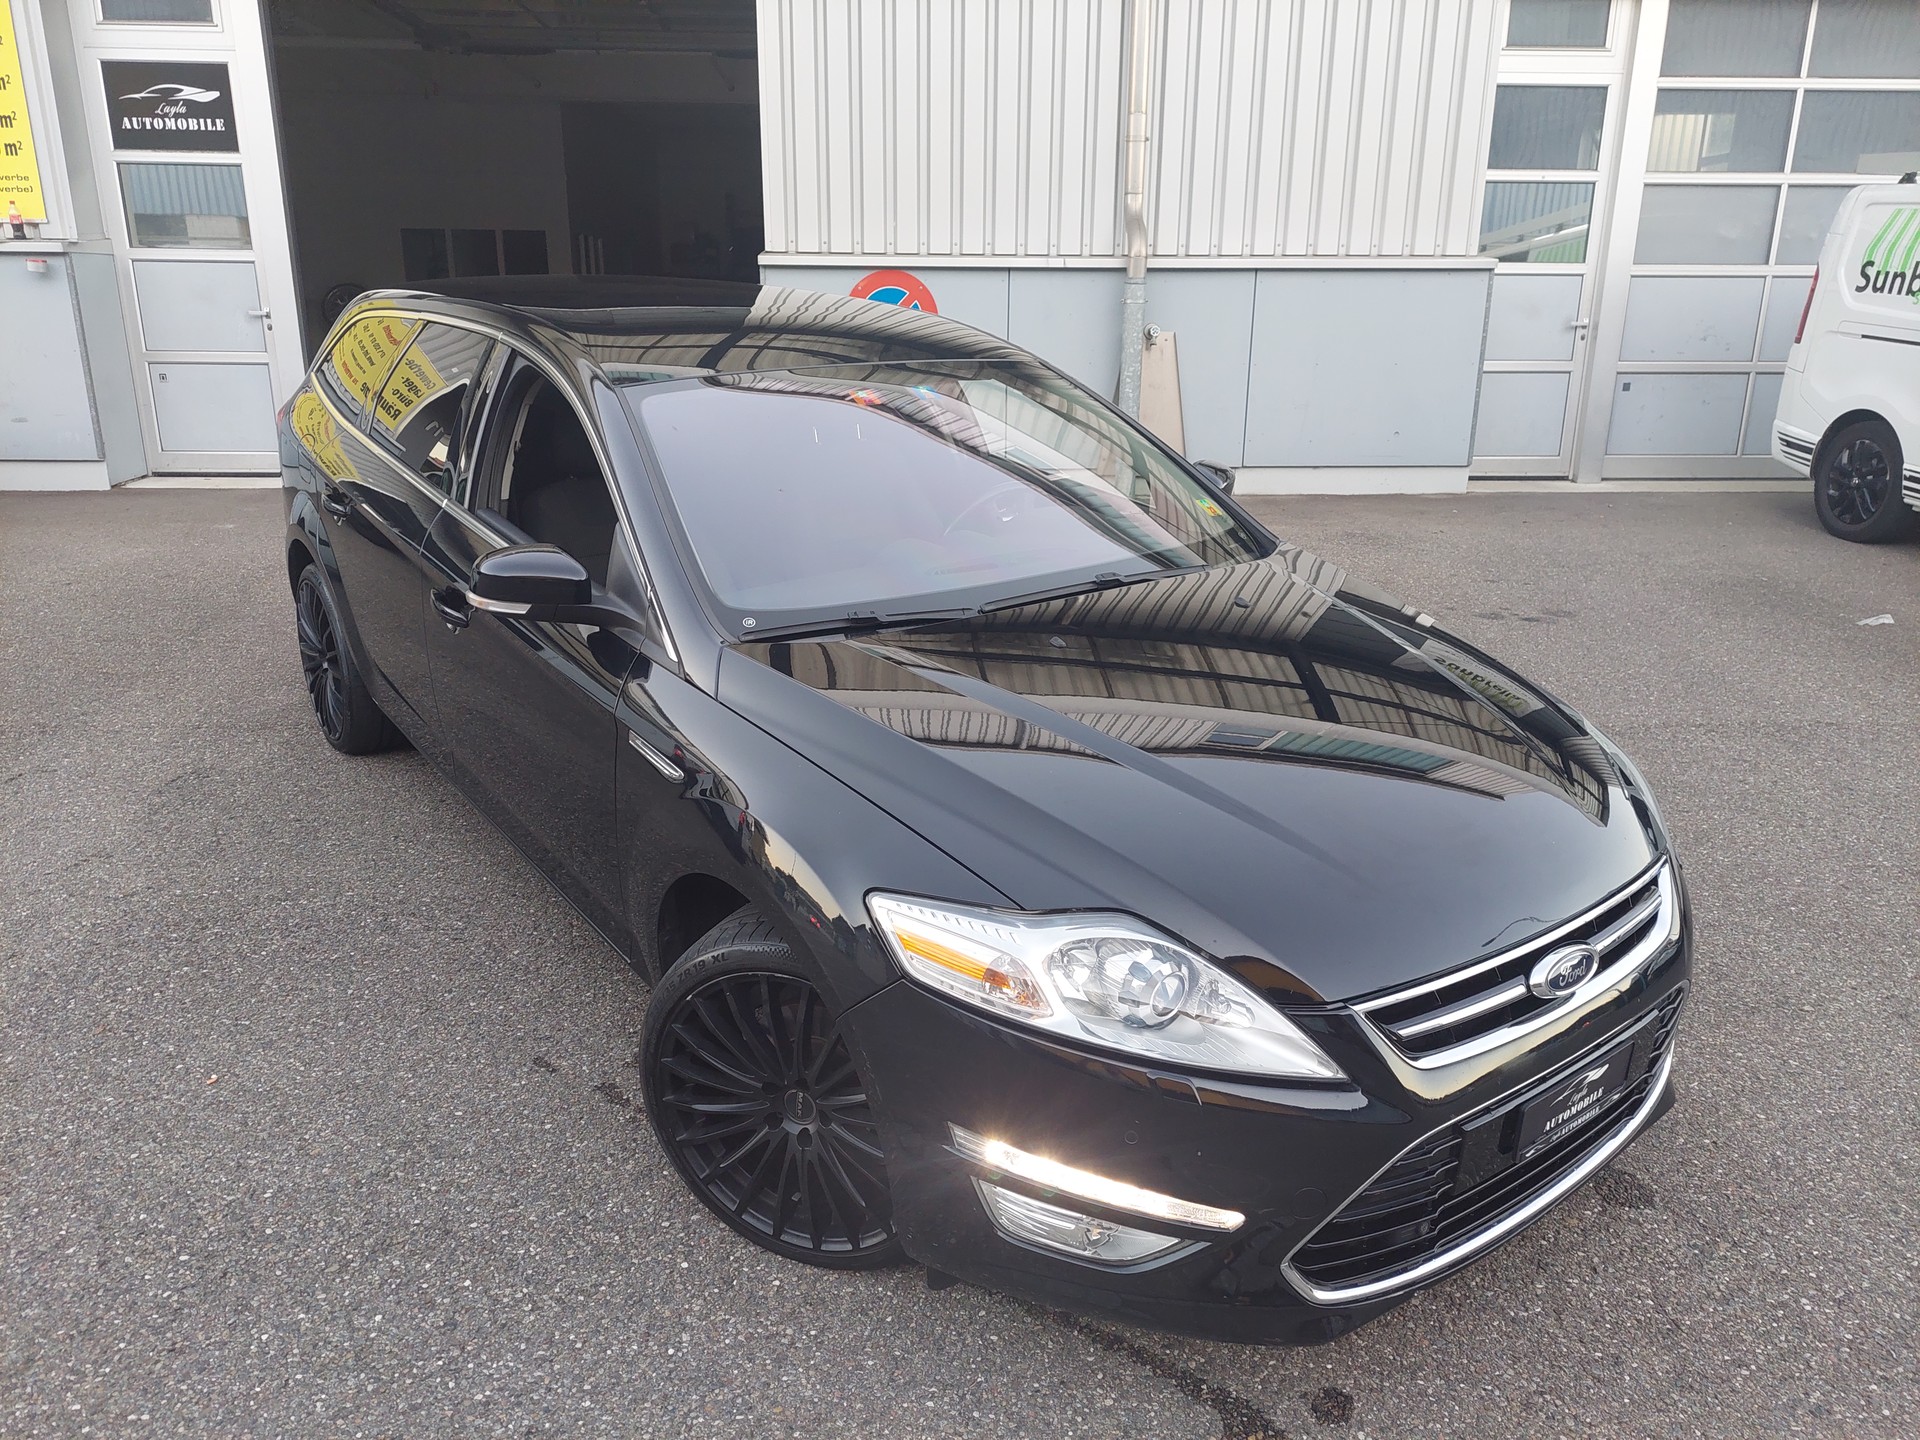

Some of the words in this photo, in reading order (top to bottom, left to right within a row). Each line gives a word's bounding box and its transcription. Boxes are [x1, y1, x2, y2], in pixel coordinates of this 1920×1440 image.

[155, 100, 187, 118] Layla
[121, 116, 226, 131] AUTOMOBILE
[1854, 260, 1920, 297] Sunb
[711, 952, 729, 965] XL
[1559, 958, 1588, 987] Ford
[1543, 1086, 1604, 1133] AUTOMOBILE
